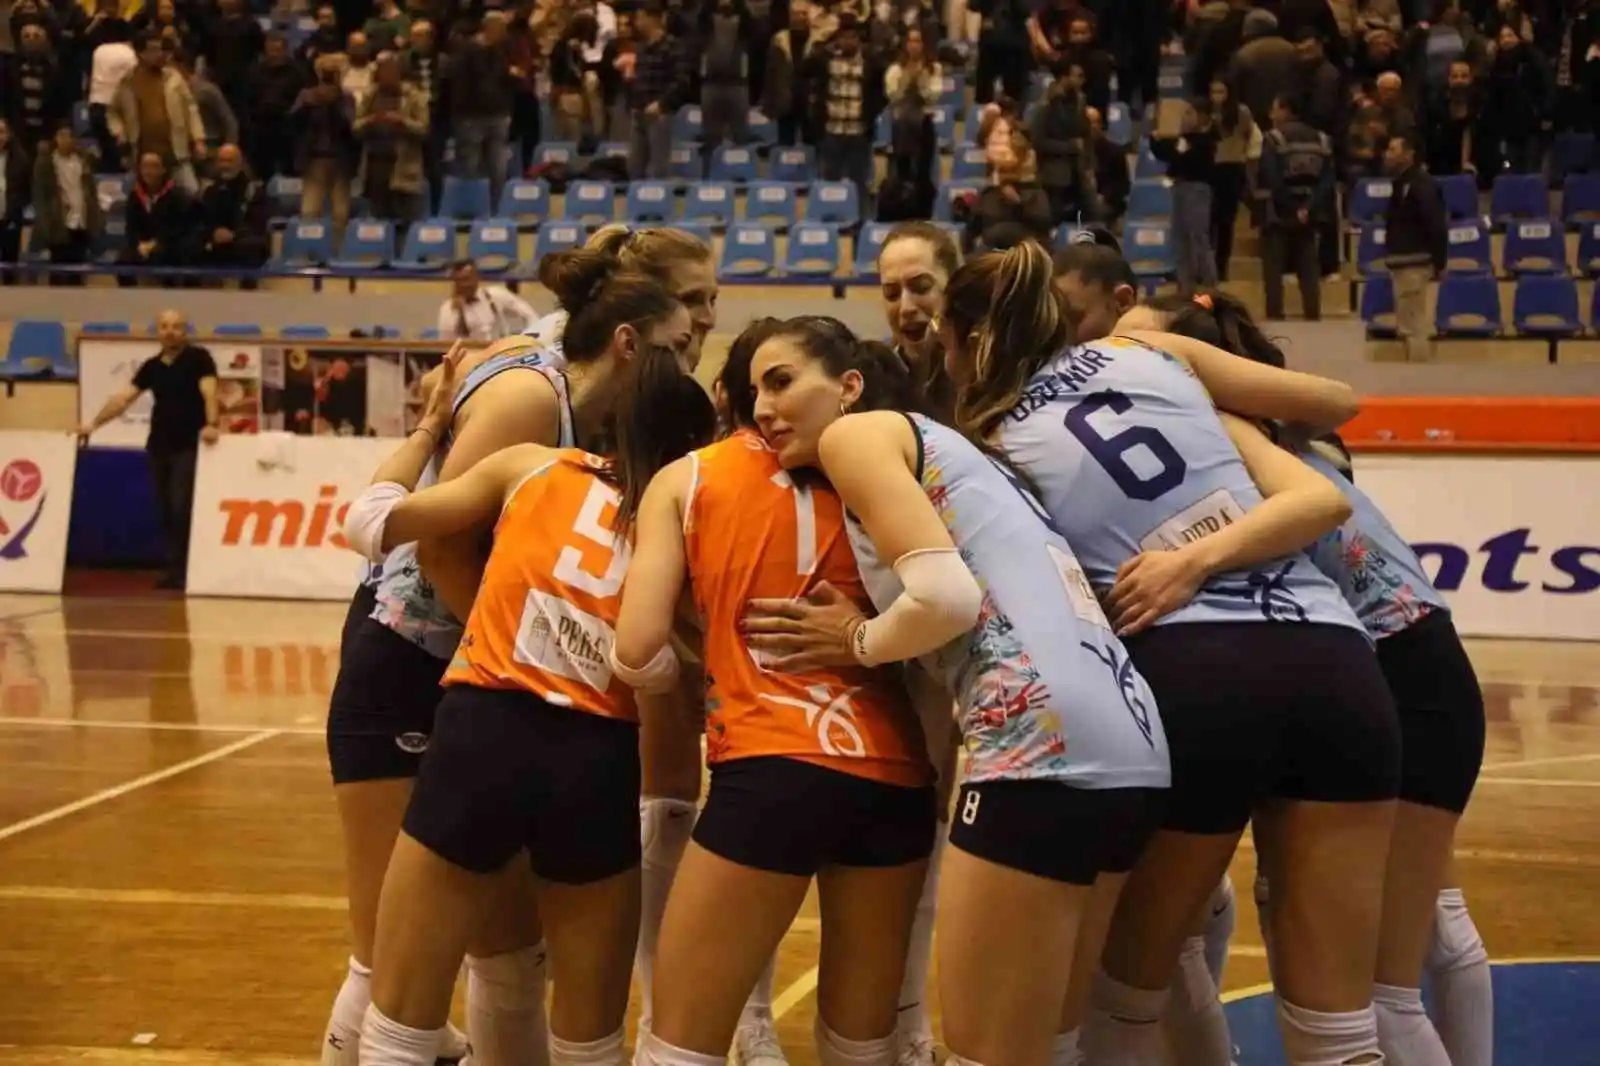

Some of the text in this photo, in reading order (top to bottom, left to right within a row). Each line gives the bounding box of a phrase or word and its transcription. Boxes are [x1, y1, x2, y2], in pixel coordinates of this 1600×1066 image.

[1063, 389, 1187, 502] 6
[552, 476, 632, 599] 5
[962, 790, 981, 825] 8
